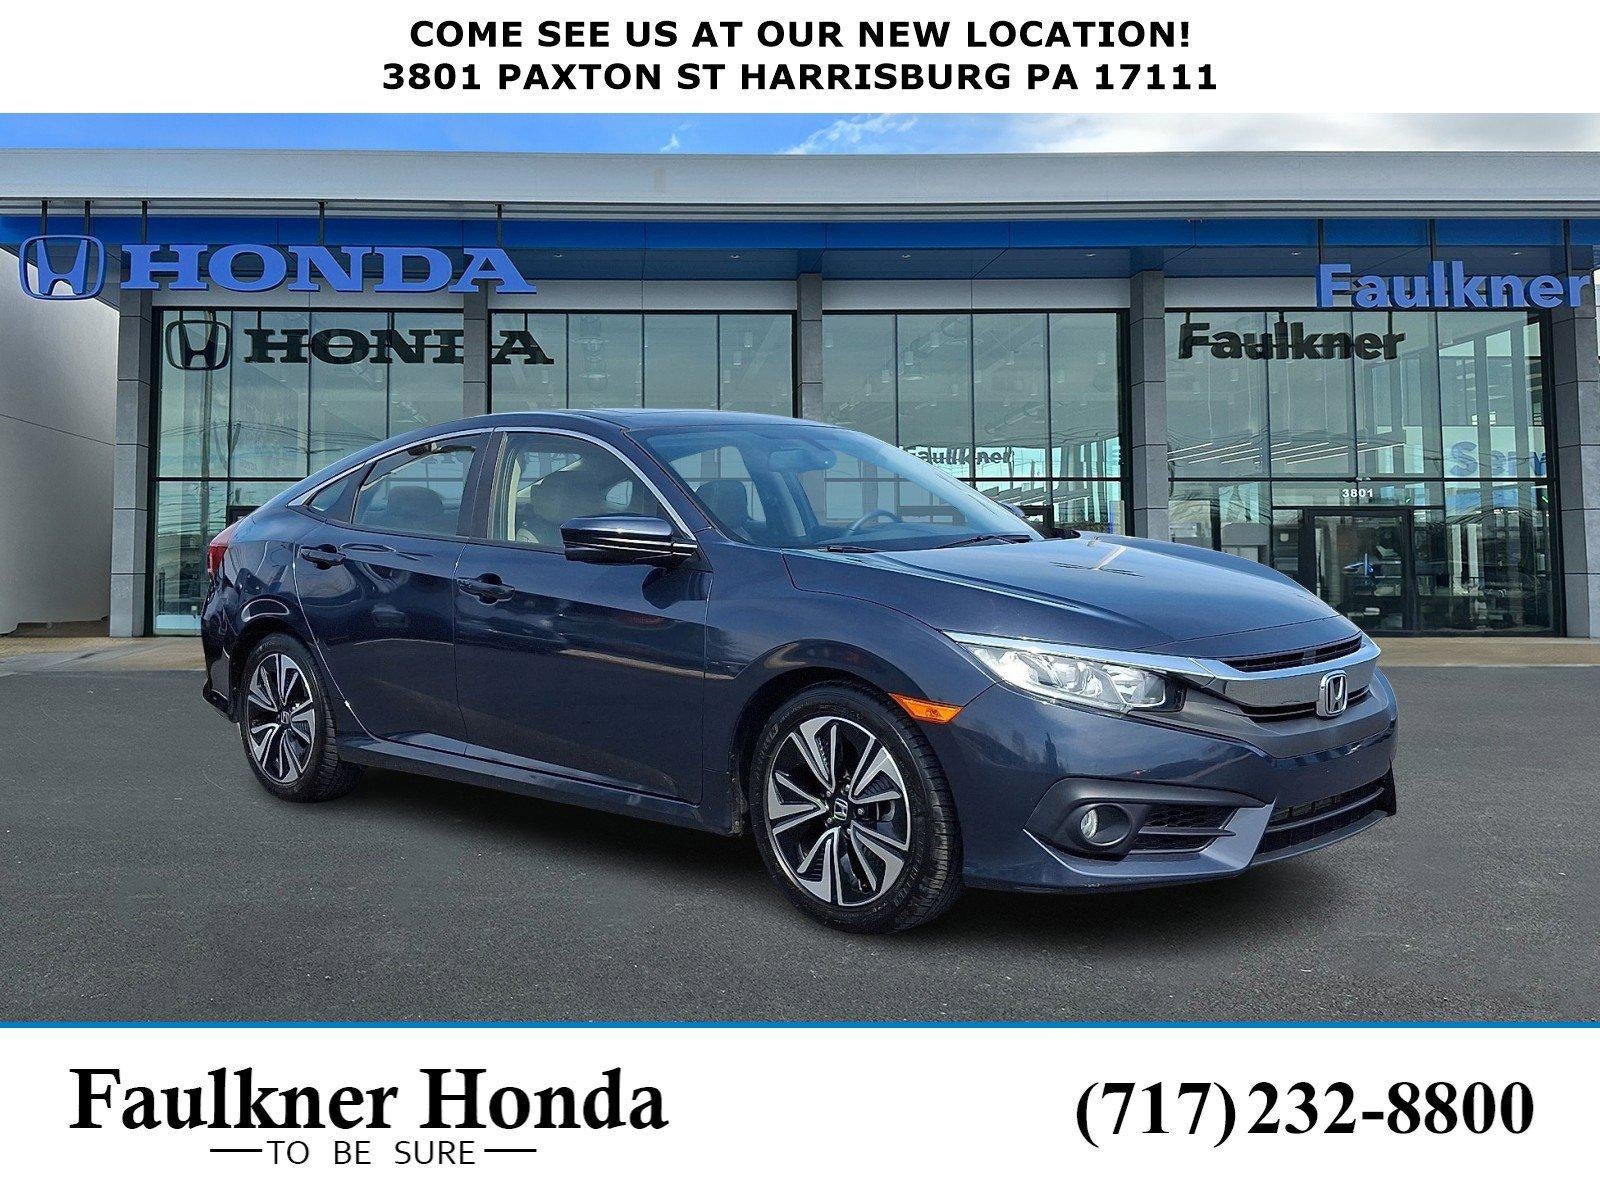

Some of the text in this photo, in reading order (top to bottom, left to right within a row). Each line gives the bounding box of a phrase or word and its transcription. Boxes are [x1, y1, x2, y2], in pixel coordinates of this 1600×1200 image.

[121, 244, 537, 294] HONDA
[1317, 260, 1591, 308] Faulkner
[1178, 322, 1405, 361] Faulkner
[1341, 487, 1374, 499] 3801
